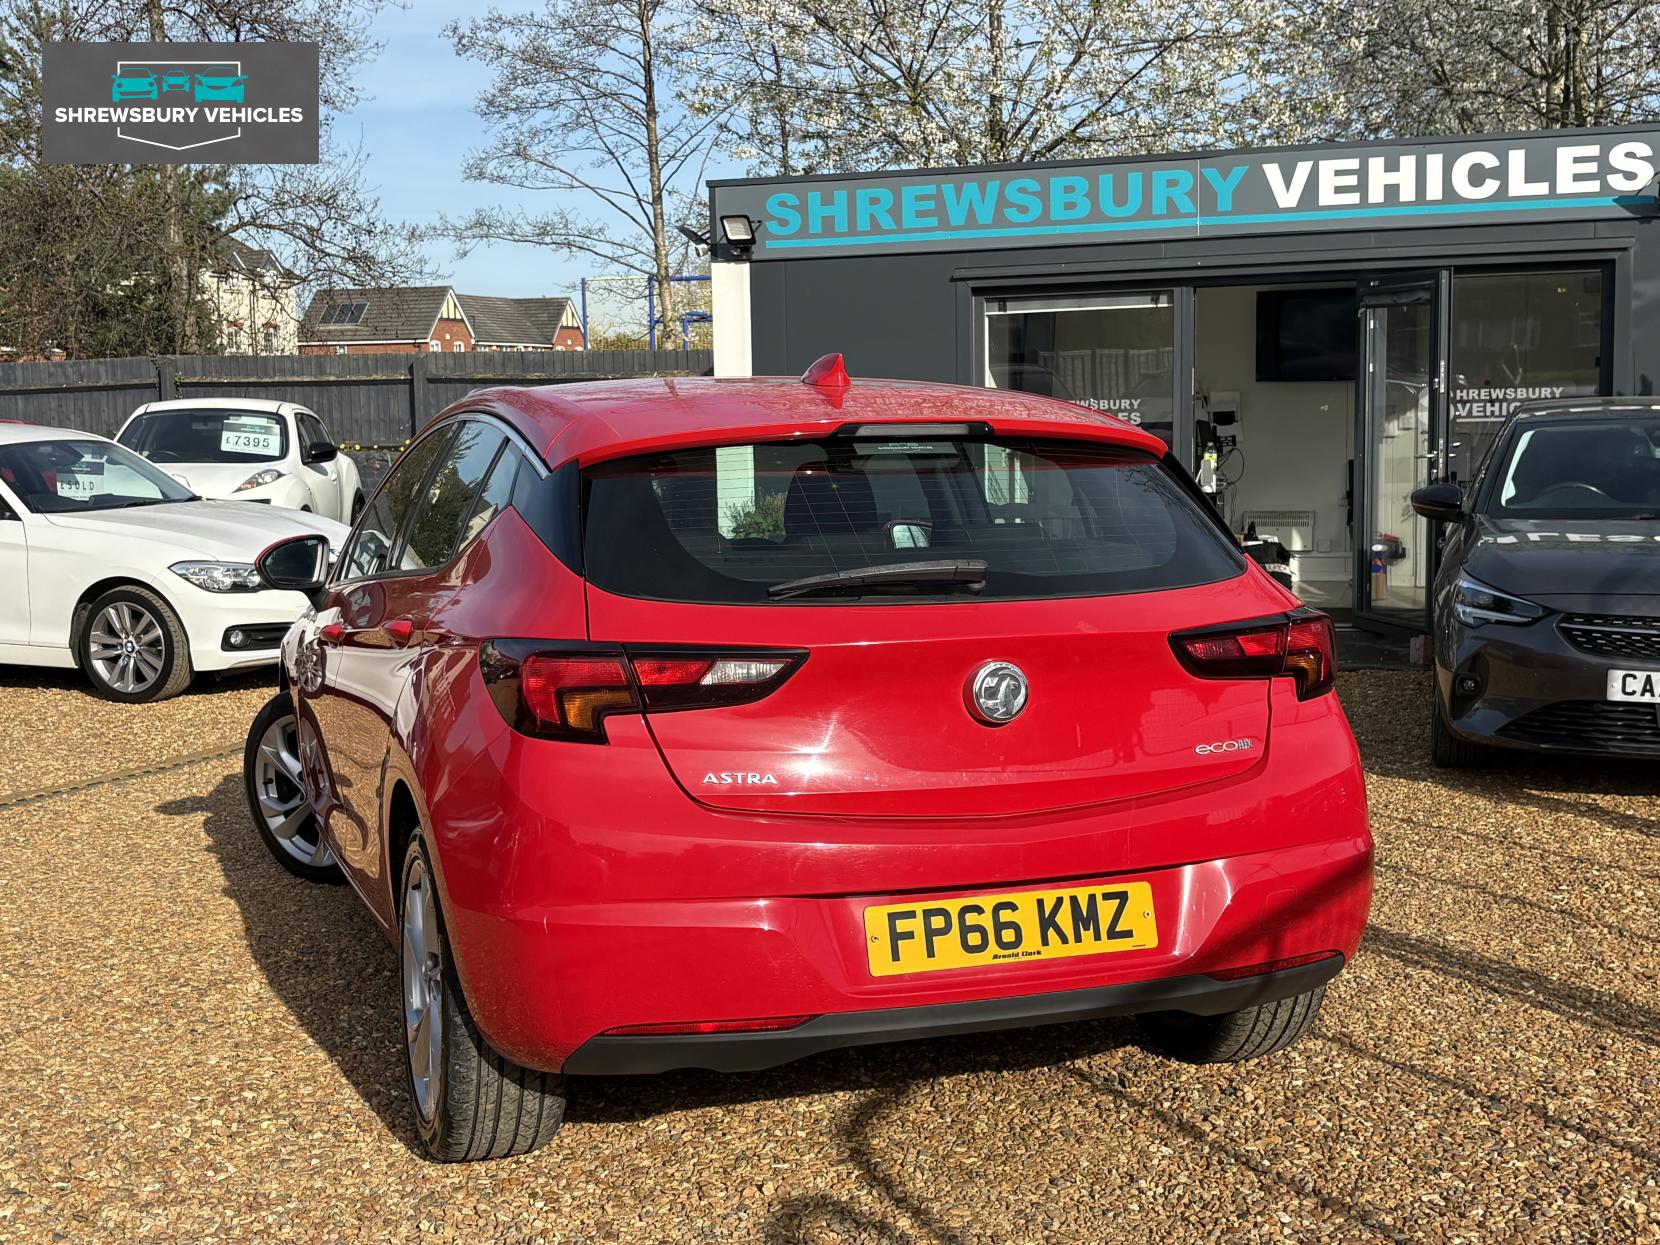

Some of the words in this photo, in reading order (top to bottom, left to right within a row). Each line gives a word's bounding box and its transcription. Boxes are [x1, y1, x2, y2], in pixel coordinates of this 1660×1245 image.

[765, 165, 1249, 236] SHREWSBURY
[1262, 141, 1655, 209] VEHICLES
[1455, 386, 1564, 400] HREWSBURY
[1621, 672, 1660, 698] CA
[702, 772, 778, 784] ASTRA
[887, 901, 1023, 962] FP66
[1036, 890, 1134, 946] KMZ
[992, 951, 1019, 960] Arnold
[1021, 949, 1042, 957] Clark
